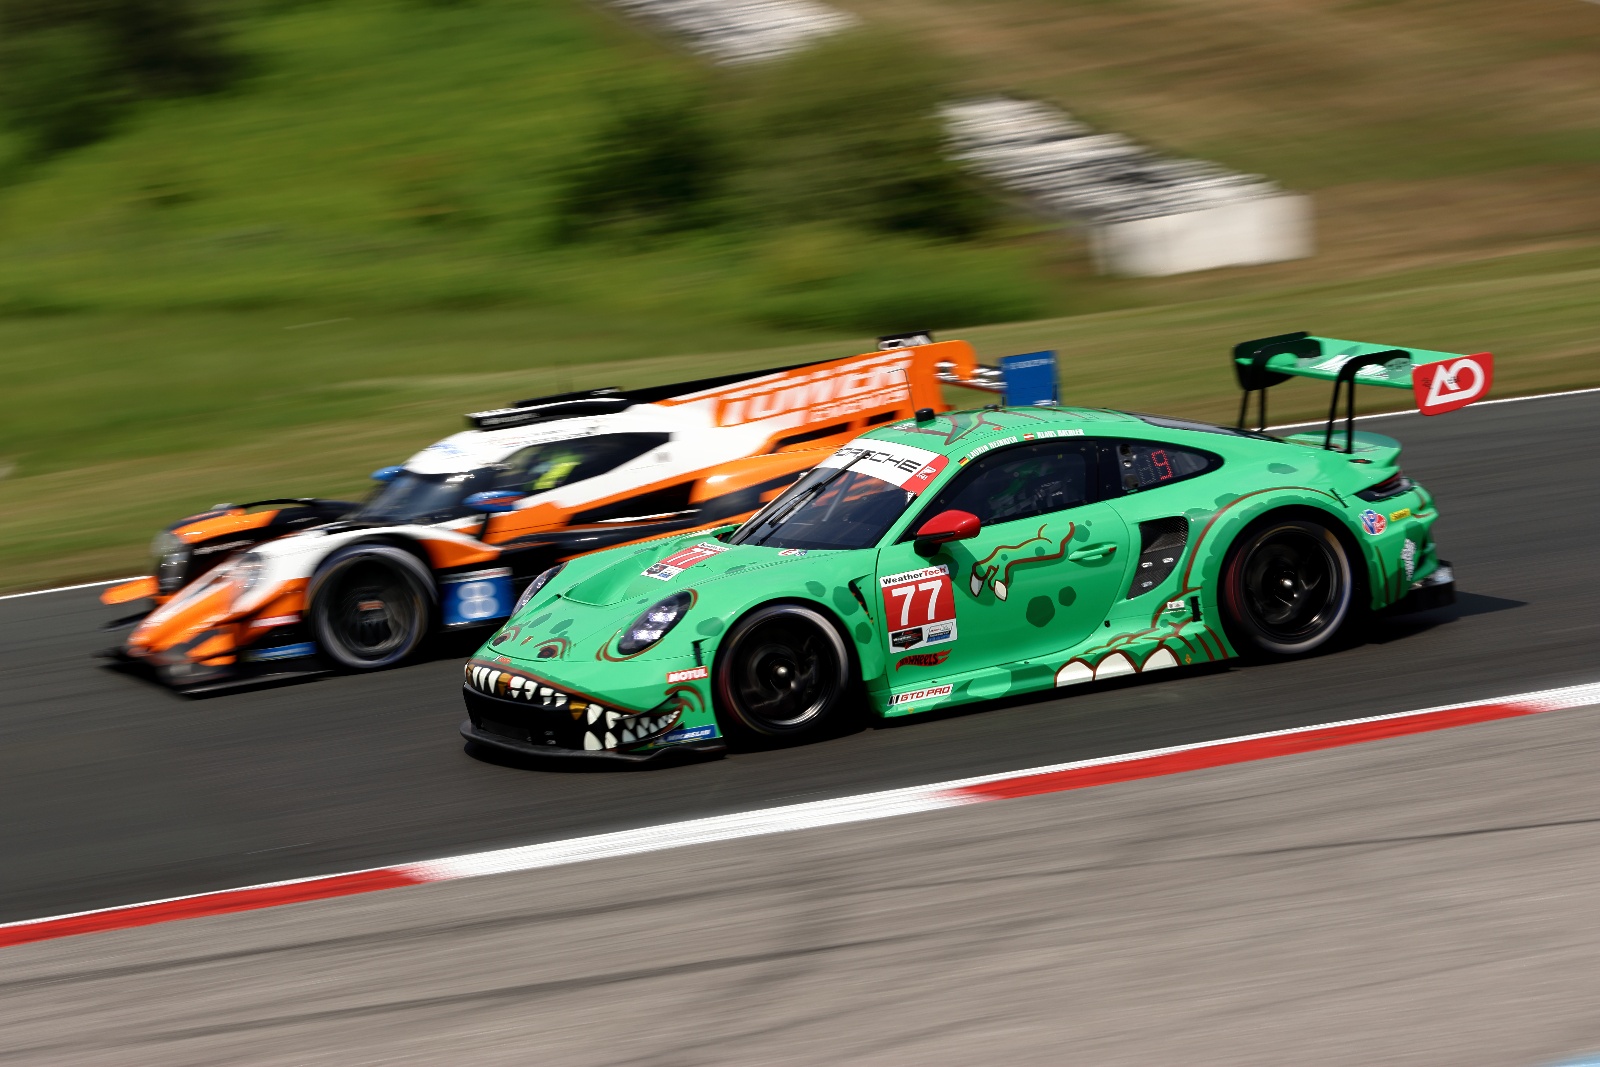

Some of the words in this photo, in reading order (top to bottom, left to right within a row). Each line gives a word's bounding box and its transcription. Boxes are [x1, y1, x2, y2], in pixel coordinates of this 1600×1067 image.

[882, 566, 947, 585] WeatherTech
[457, 581, 499, 620] 8
[891, 579, 943, 626] 77
[668, 667, 708, 683] MOTUL
[926, 685, 951, 697] PRO
